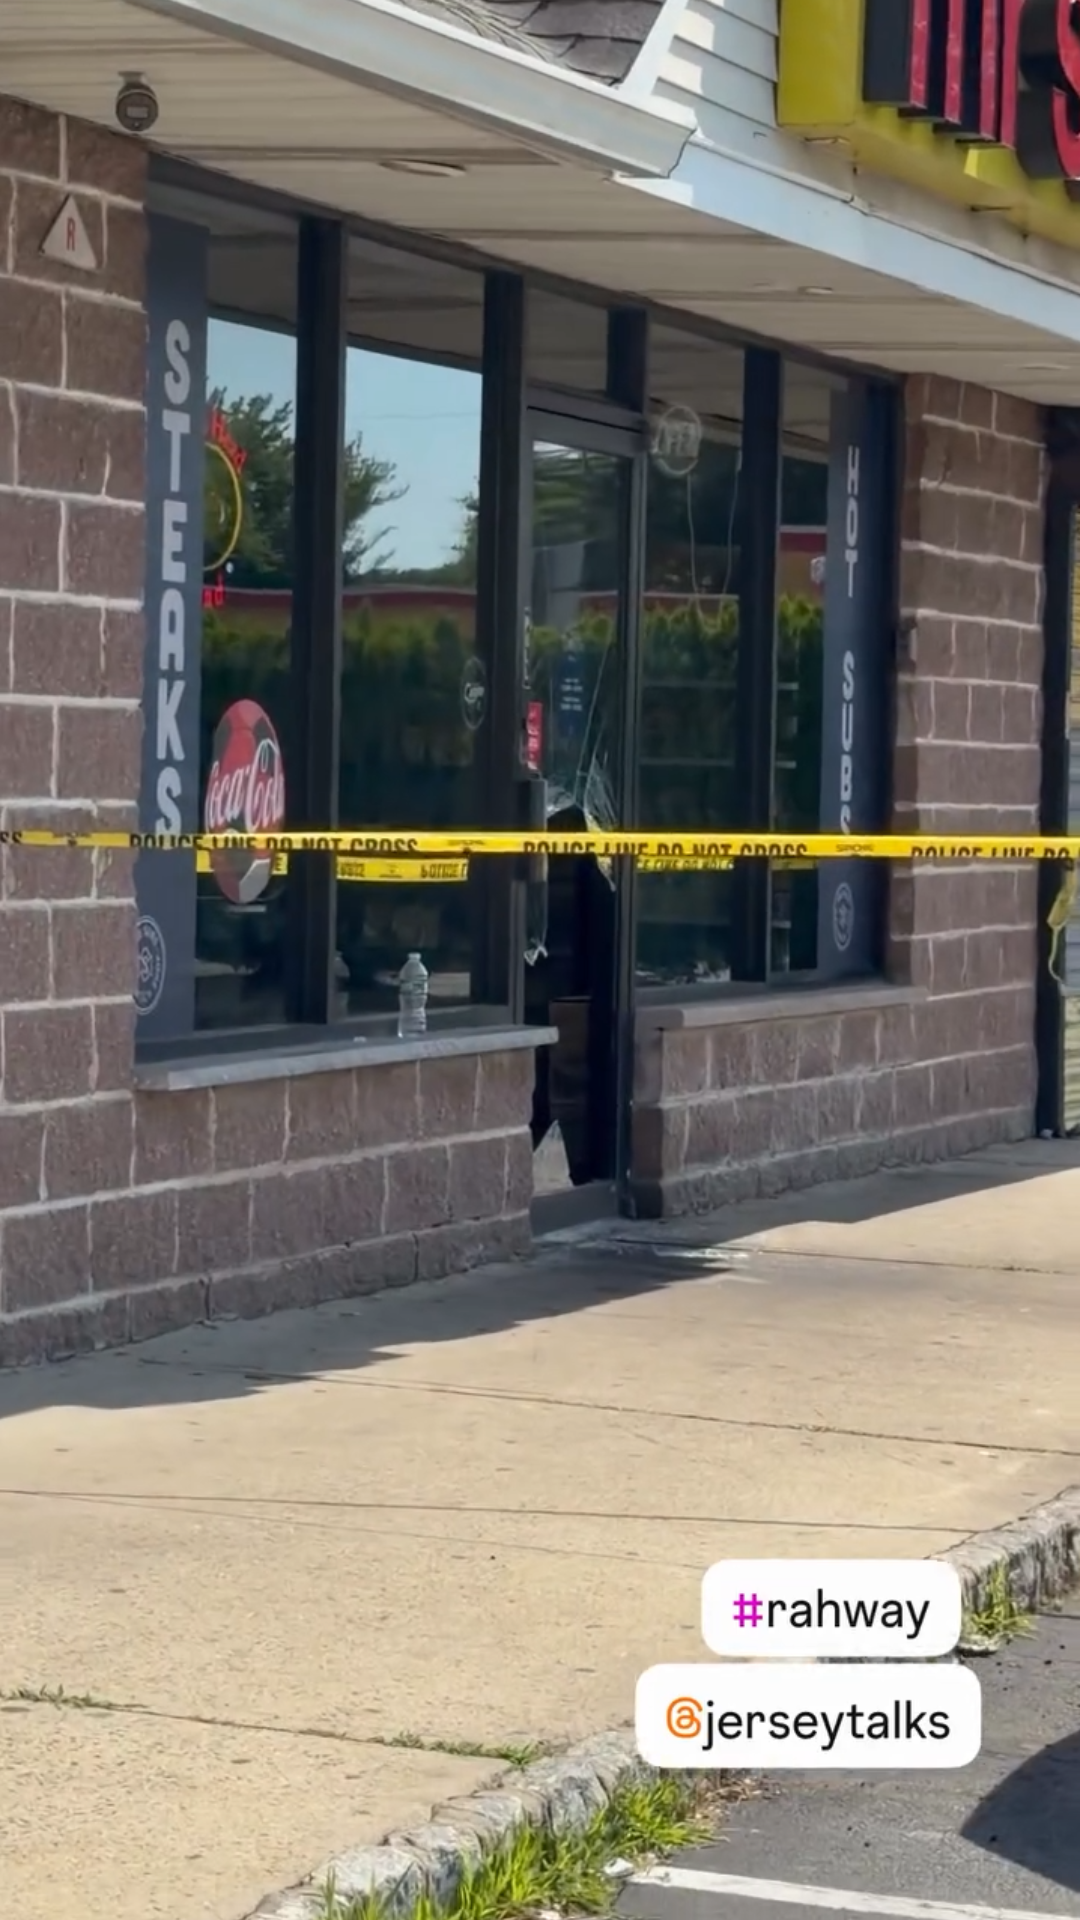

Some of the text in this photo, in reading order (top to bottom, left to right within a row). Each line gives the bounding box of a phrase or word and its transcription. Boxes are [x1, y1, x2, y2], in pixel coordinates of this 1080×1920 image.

[65, 216, 77, 252] R
[155, 319, 191, 849] STEAKS
[844, 445, 860, 598] HOT
